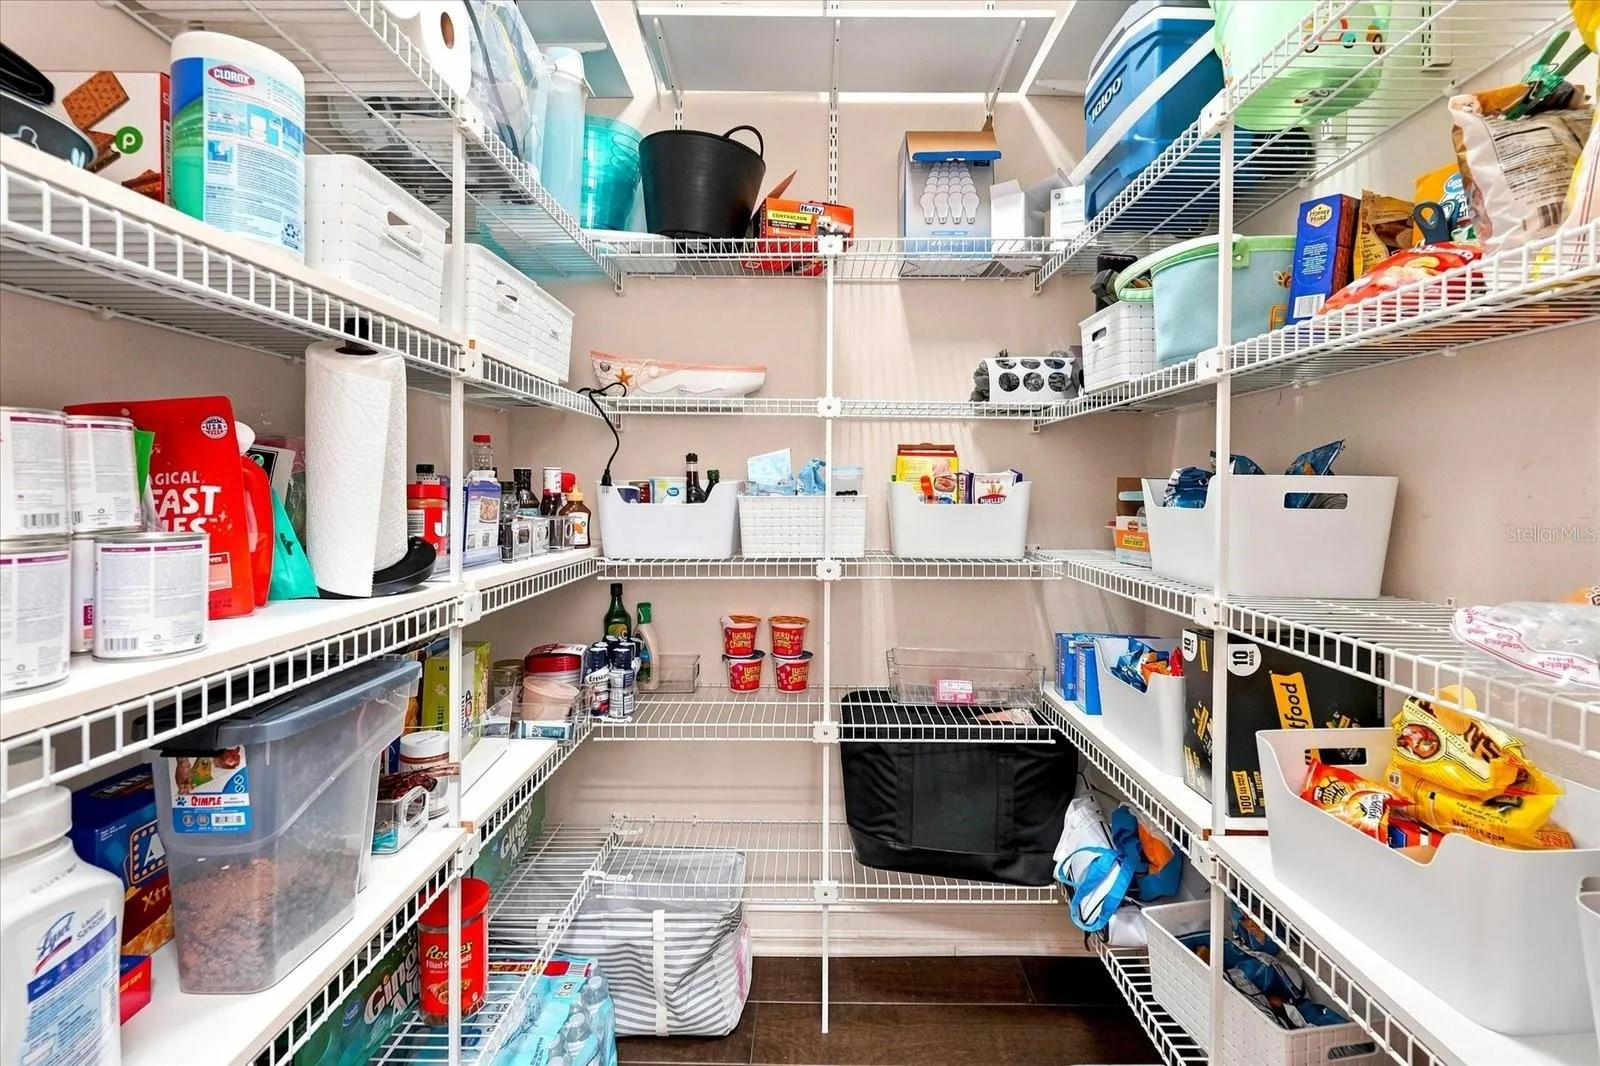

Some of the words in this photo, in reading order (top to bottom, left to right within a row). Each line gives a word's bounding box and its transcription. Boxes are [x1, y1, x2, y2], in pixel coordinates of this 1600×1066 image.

[213, 68, 250, 85] CLOROX
[1090, 77, 1122, 121] IGLOO
[801, 205, 822, 215] Hefty
[1233, 651, 1248, 666] 10
[1280, 682, 1309, 729] tfood
